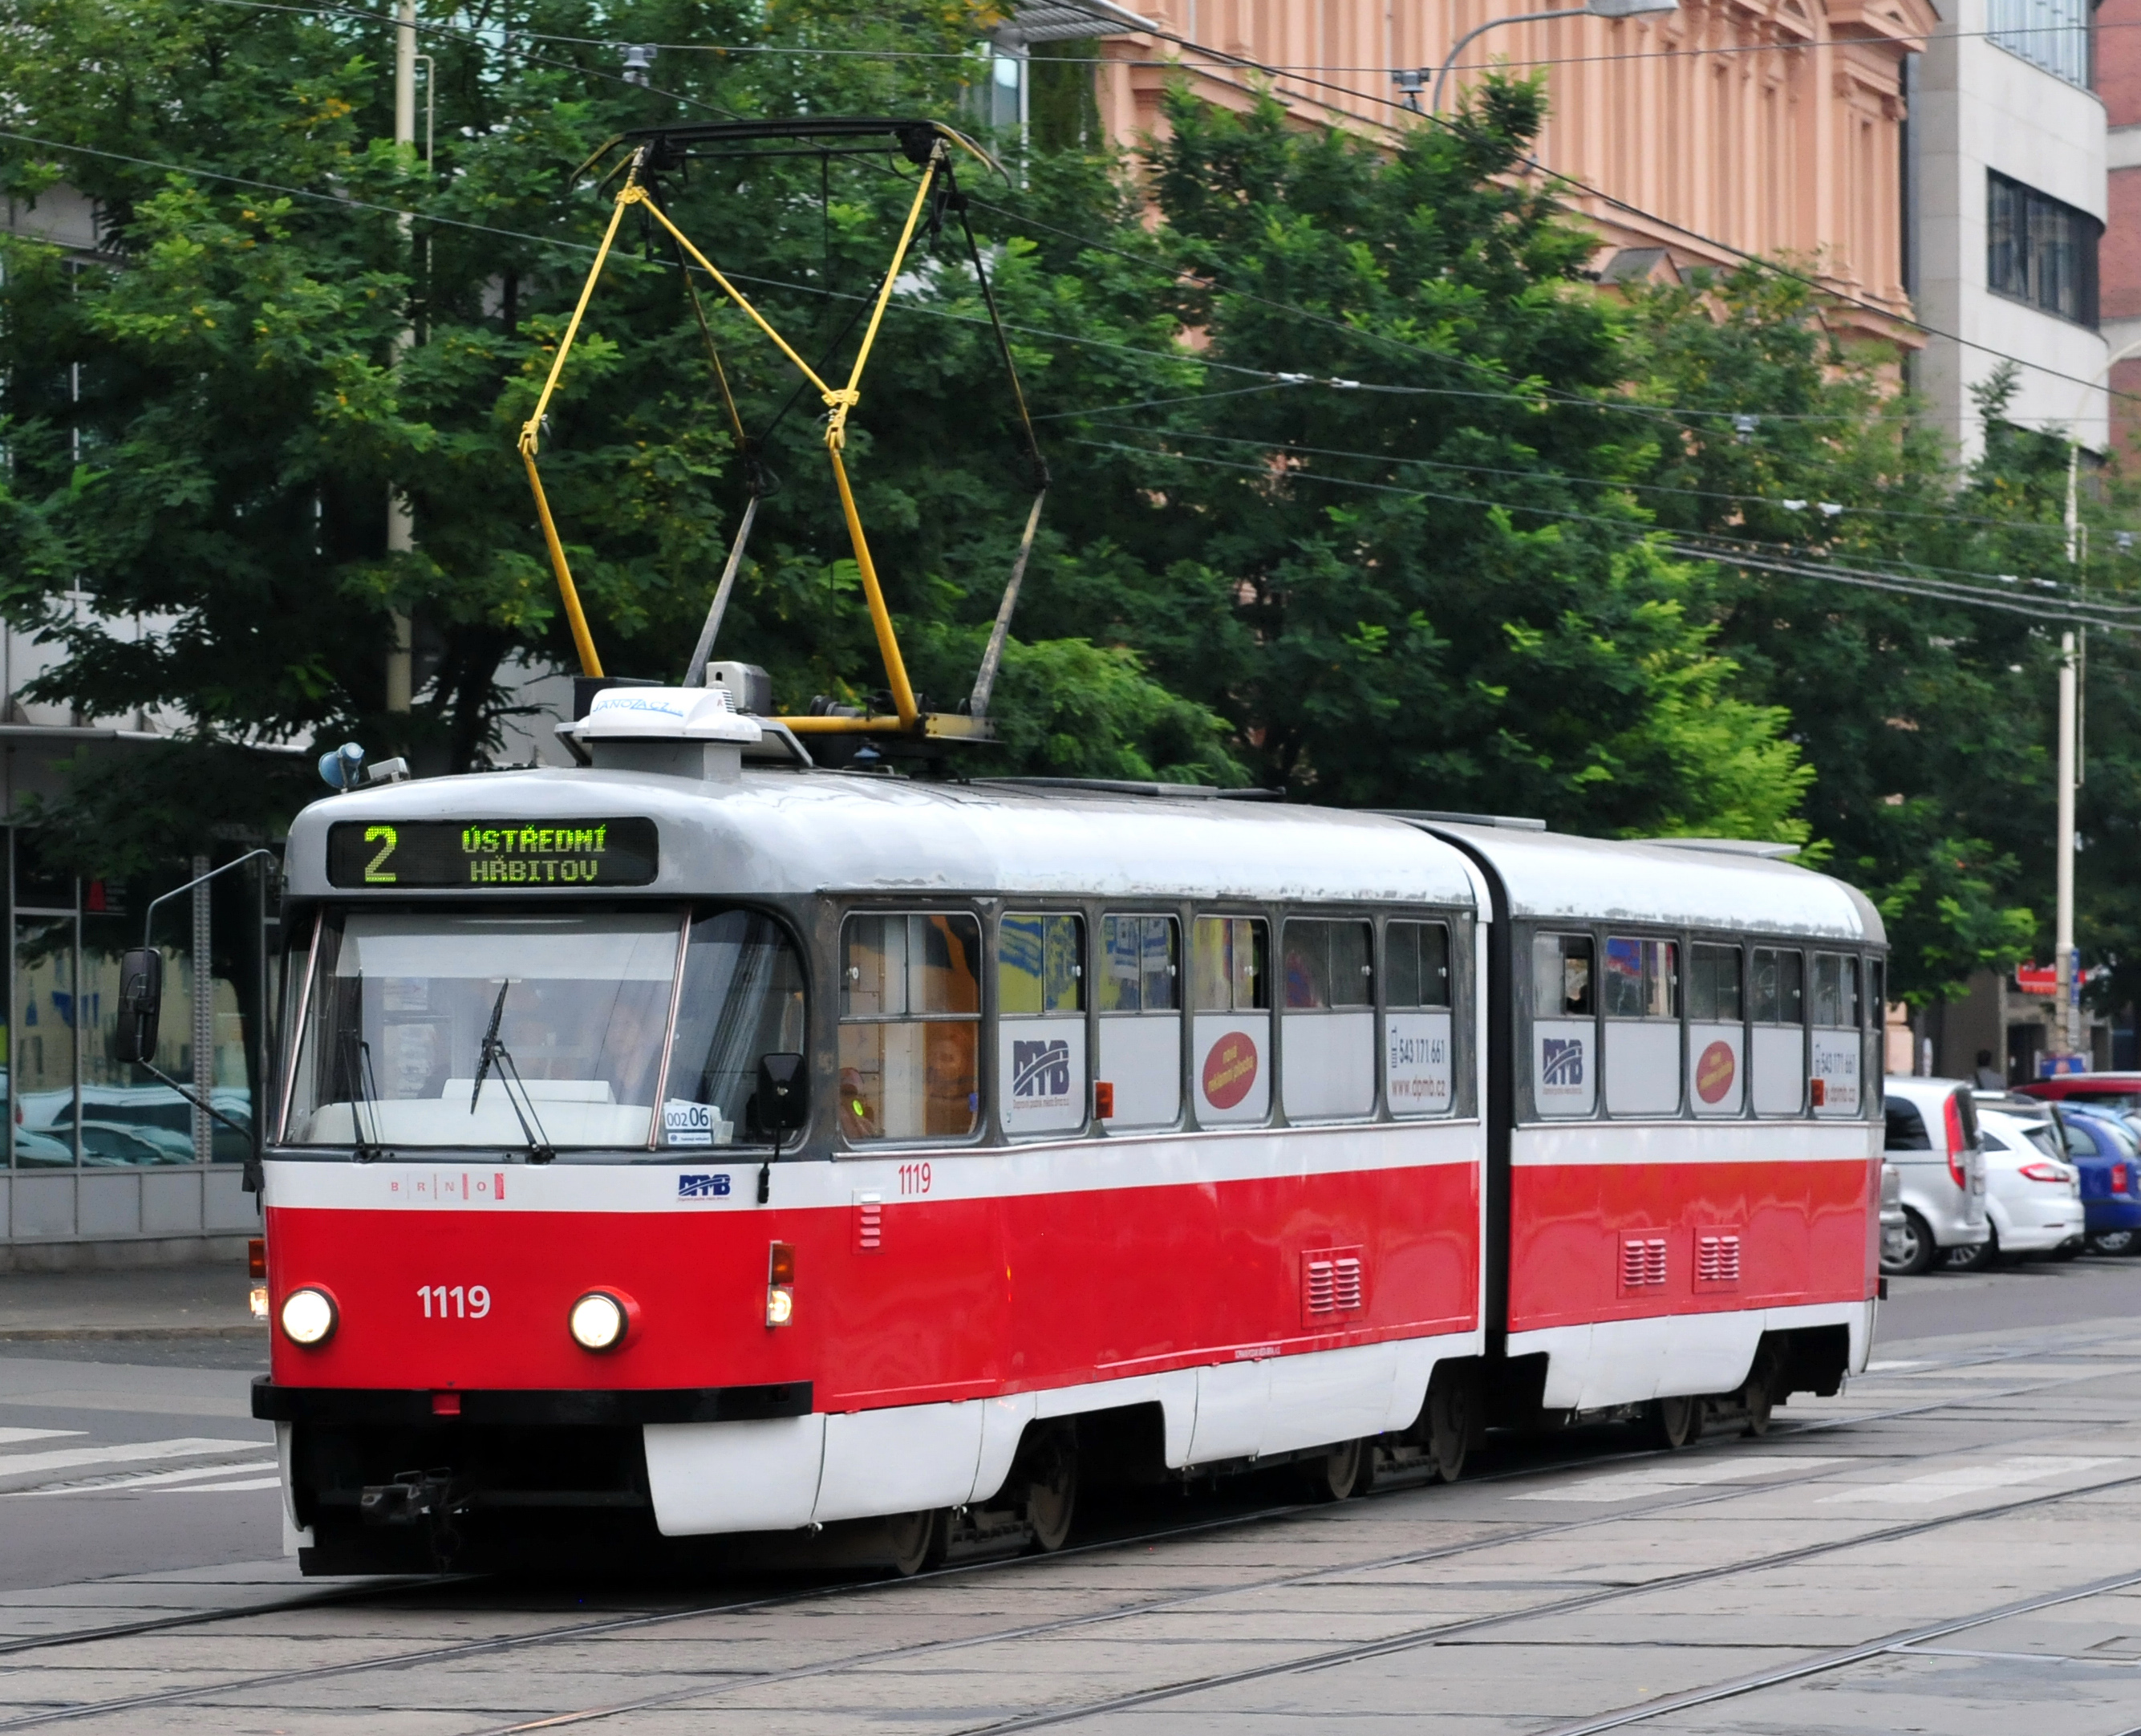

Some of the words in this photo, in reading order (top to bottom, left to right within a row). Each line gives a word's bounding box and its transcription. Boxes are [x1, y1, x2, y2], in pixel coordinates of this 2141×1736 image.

[364, 825, 397, 882] 2
[461, 824, 606, 853] ÚSTŘEDNÍ
[470, 855, 598, 882] HŘBITOV
[898, 1162, 931, 1195] 1119
[416, 1285, 491, 1319] 1119
